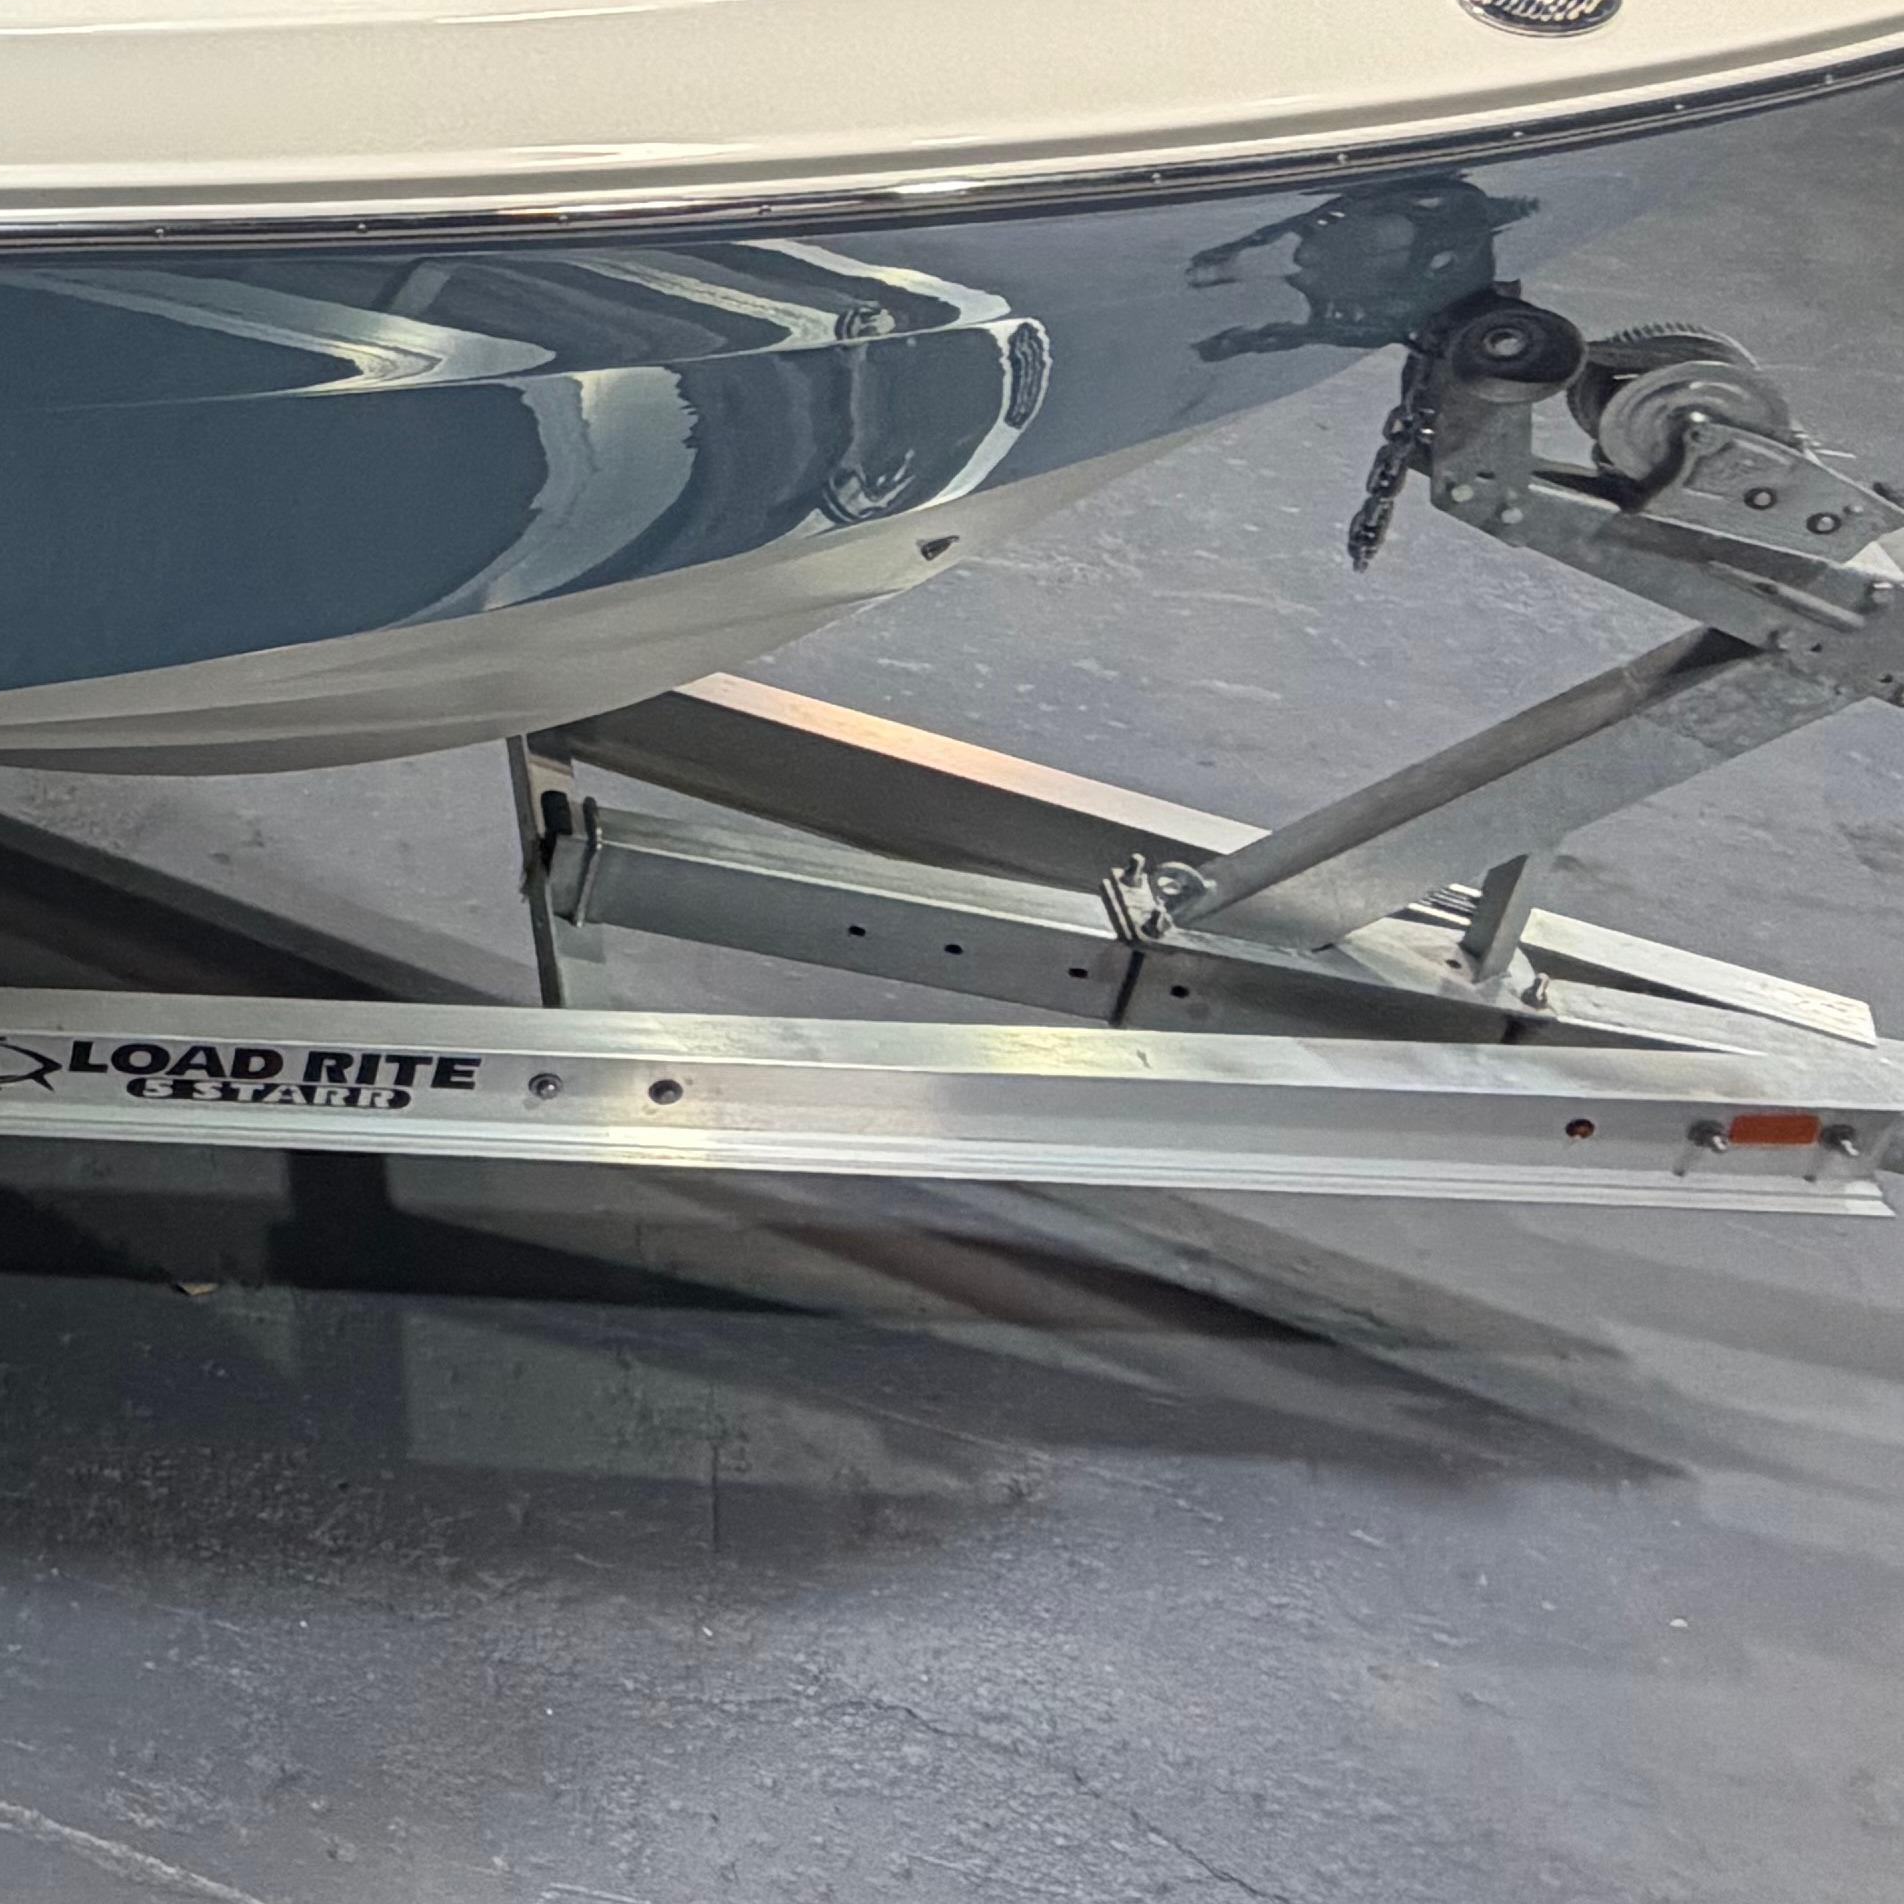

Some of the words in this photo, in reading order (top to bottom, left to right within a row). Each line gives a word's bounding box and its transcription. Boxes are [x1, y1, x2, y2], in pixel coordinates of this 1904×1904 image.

[67, 1040, 284, 1079] LOAD
[303, 1050, 483, 1090] RITE
[142, 1078, 174, 1098] 5
[191, 1080, 395, 1109] STARR
